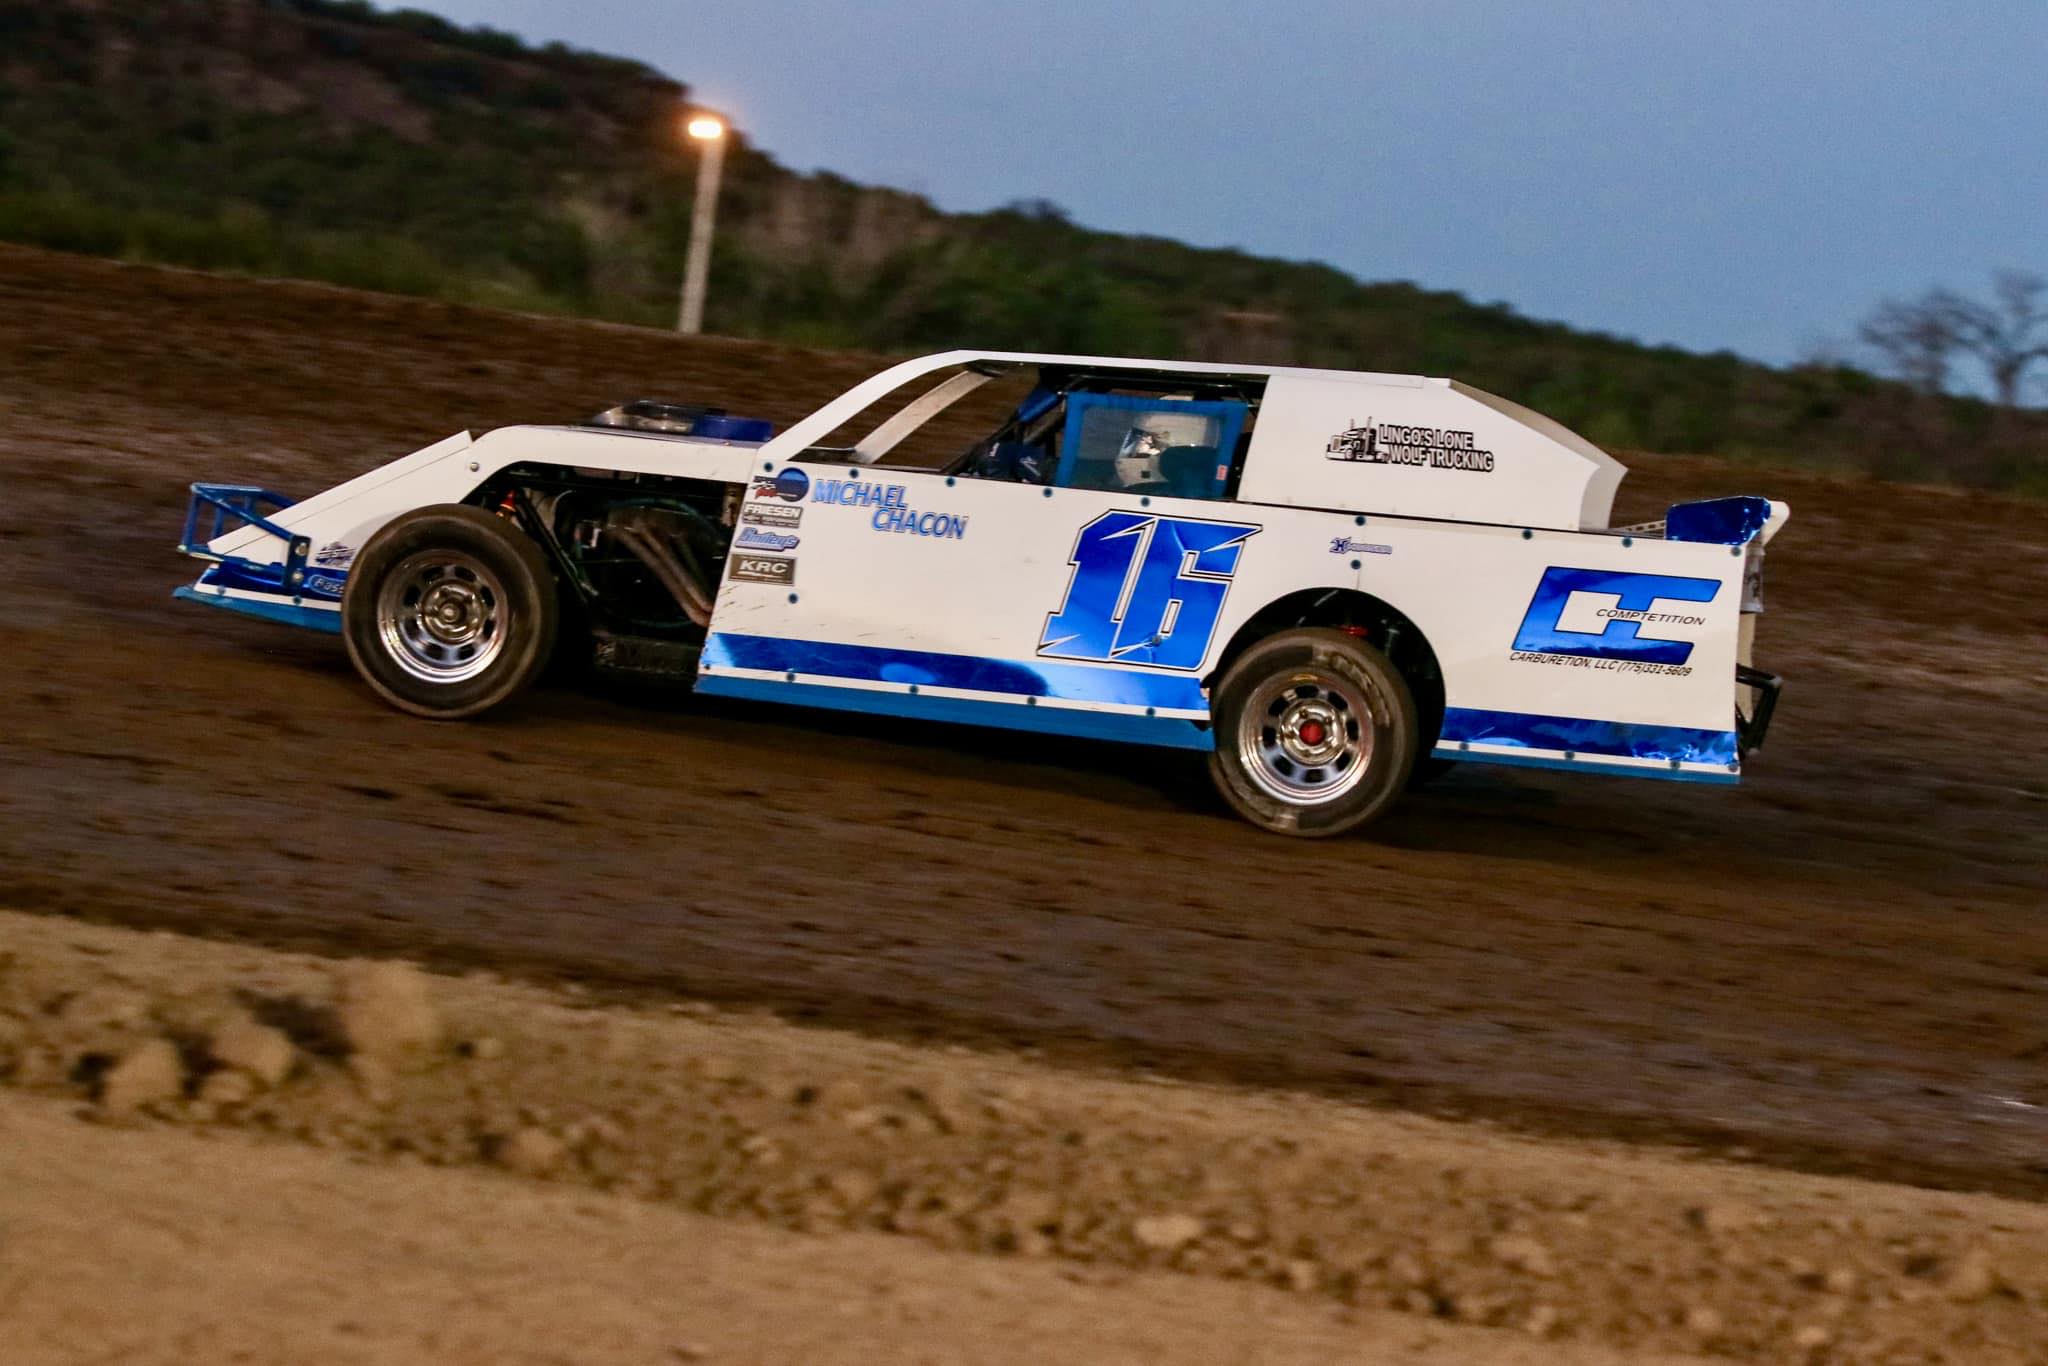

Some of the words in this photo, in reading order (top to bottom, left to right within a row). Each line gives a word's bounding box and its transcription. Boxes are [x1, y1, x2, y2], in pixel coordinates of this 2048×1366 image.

[1378, 424, 1433, 447] LINGO'S
[1434, 429, 1474, 450] LONE
[1390, 445, 1428, 466] WOLF
[1428, 449, 1494, 472] TRUCKING
[812, 479, 909, 510] MICHAEL
[744, 502, 802, 519] FRIESEN
[872, 507, 969, 539] CHACON
[739, 559, 788, 574] KRC
[1036, 509, 1263, 672] 16
[1595, 608, 1707, 626] COMPTETITION
[1509, 651, 1592, 669] CARBURETION,
[1594, 658, 1618, 671] LLC
[1616, 661, 1693, 678] (775)331-5609
